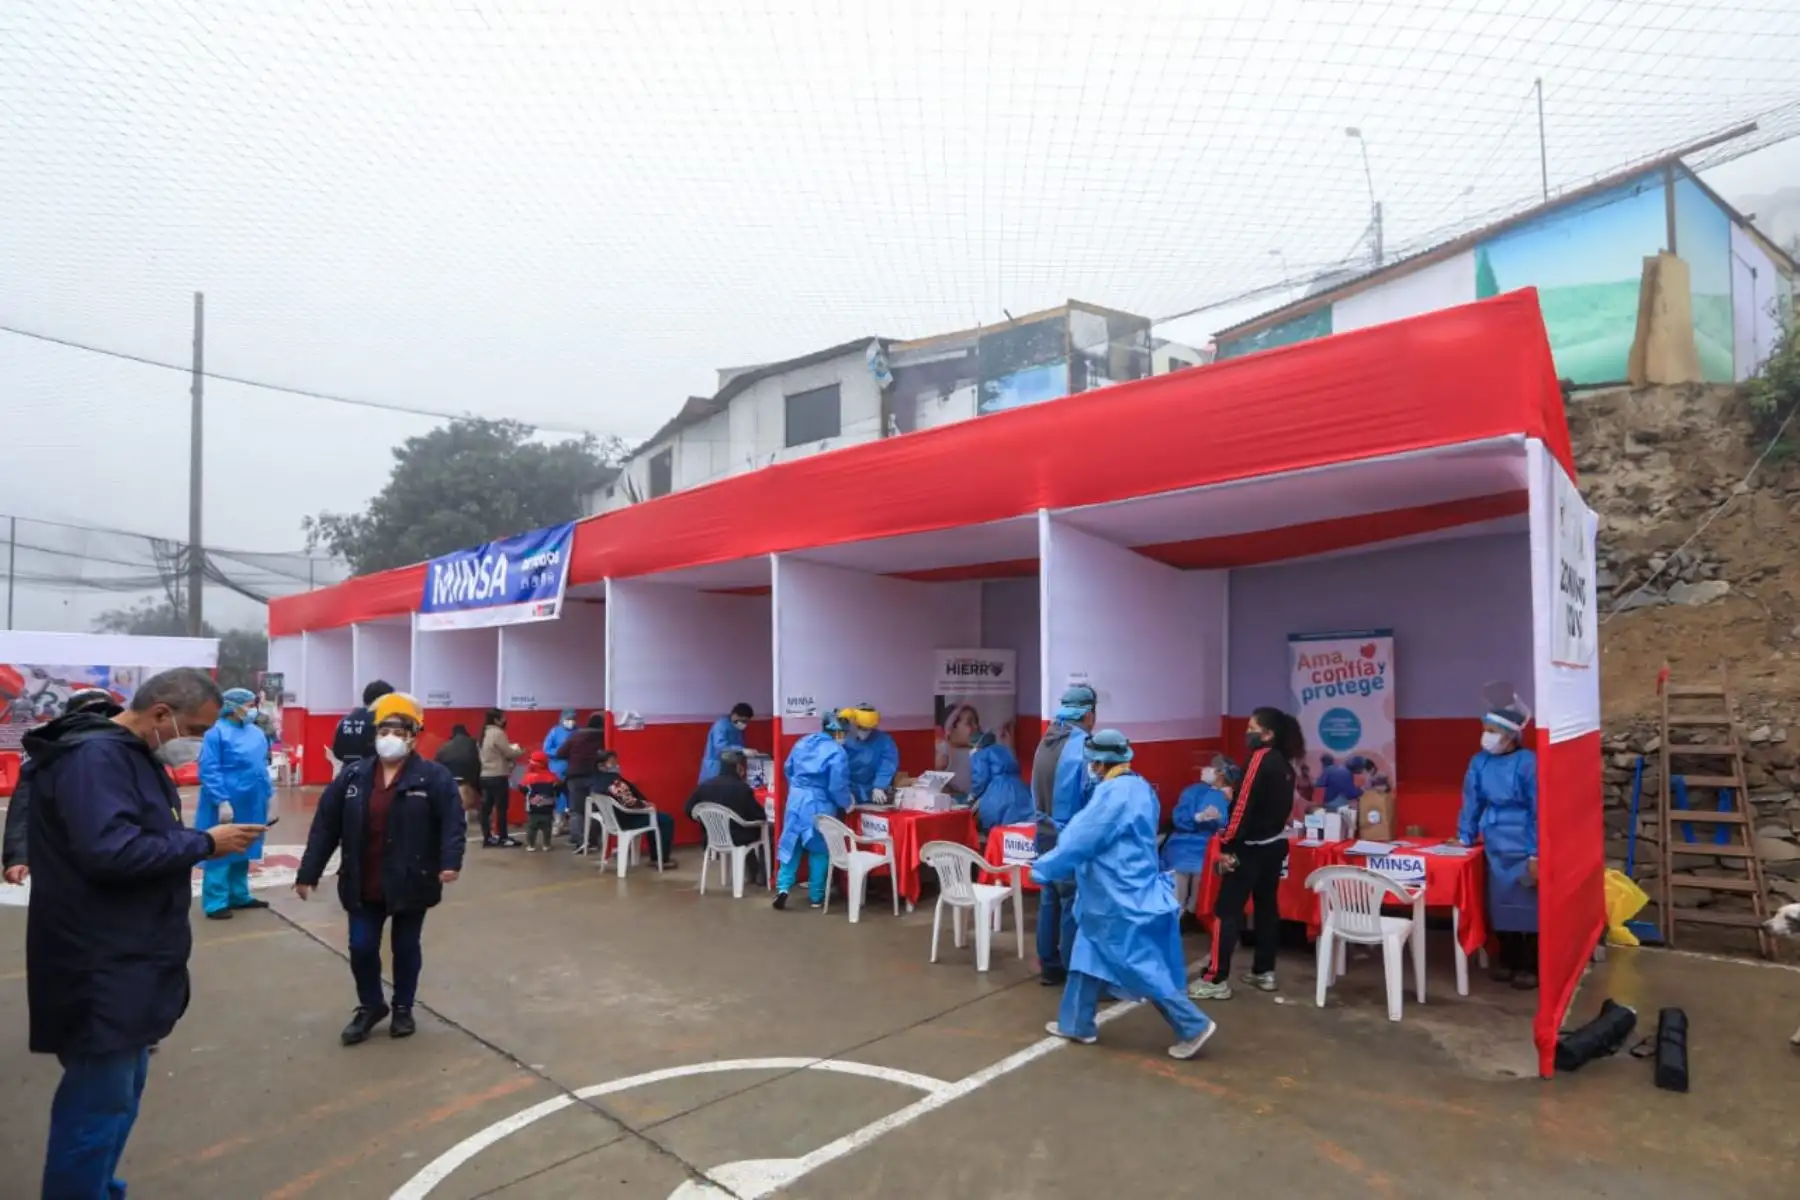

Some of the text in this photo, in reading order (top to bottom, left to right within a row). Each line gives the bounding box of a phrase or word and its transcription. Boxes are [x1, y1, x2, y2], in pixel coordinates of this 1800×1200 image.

[432, 552, 508, 605] MINSA
[1377, 659, 1386, 675] y
[1301, 676, 1385, 705] protege
[1370, 857, 1423, 873] MINSA
